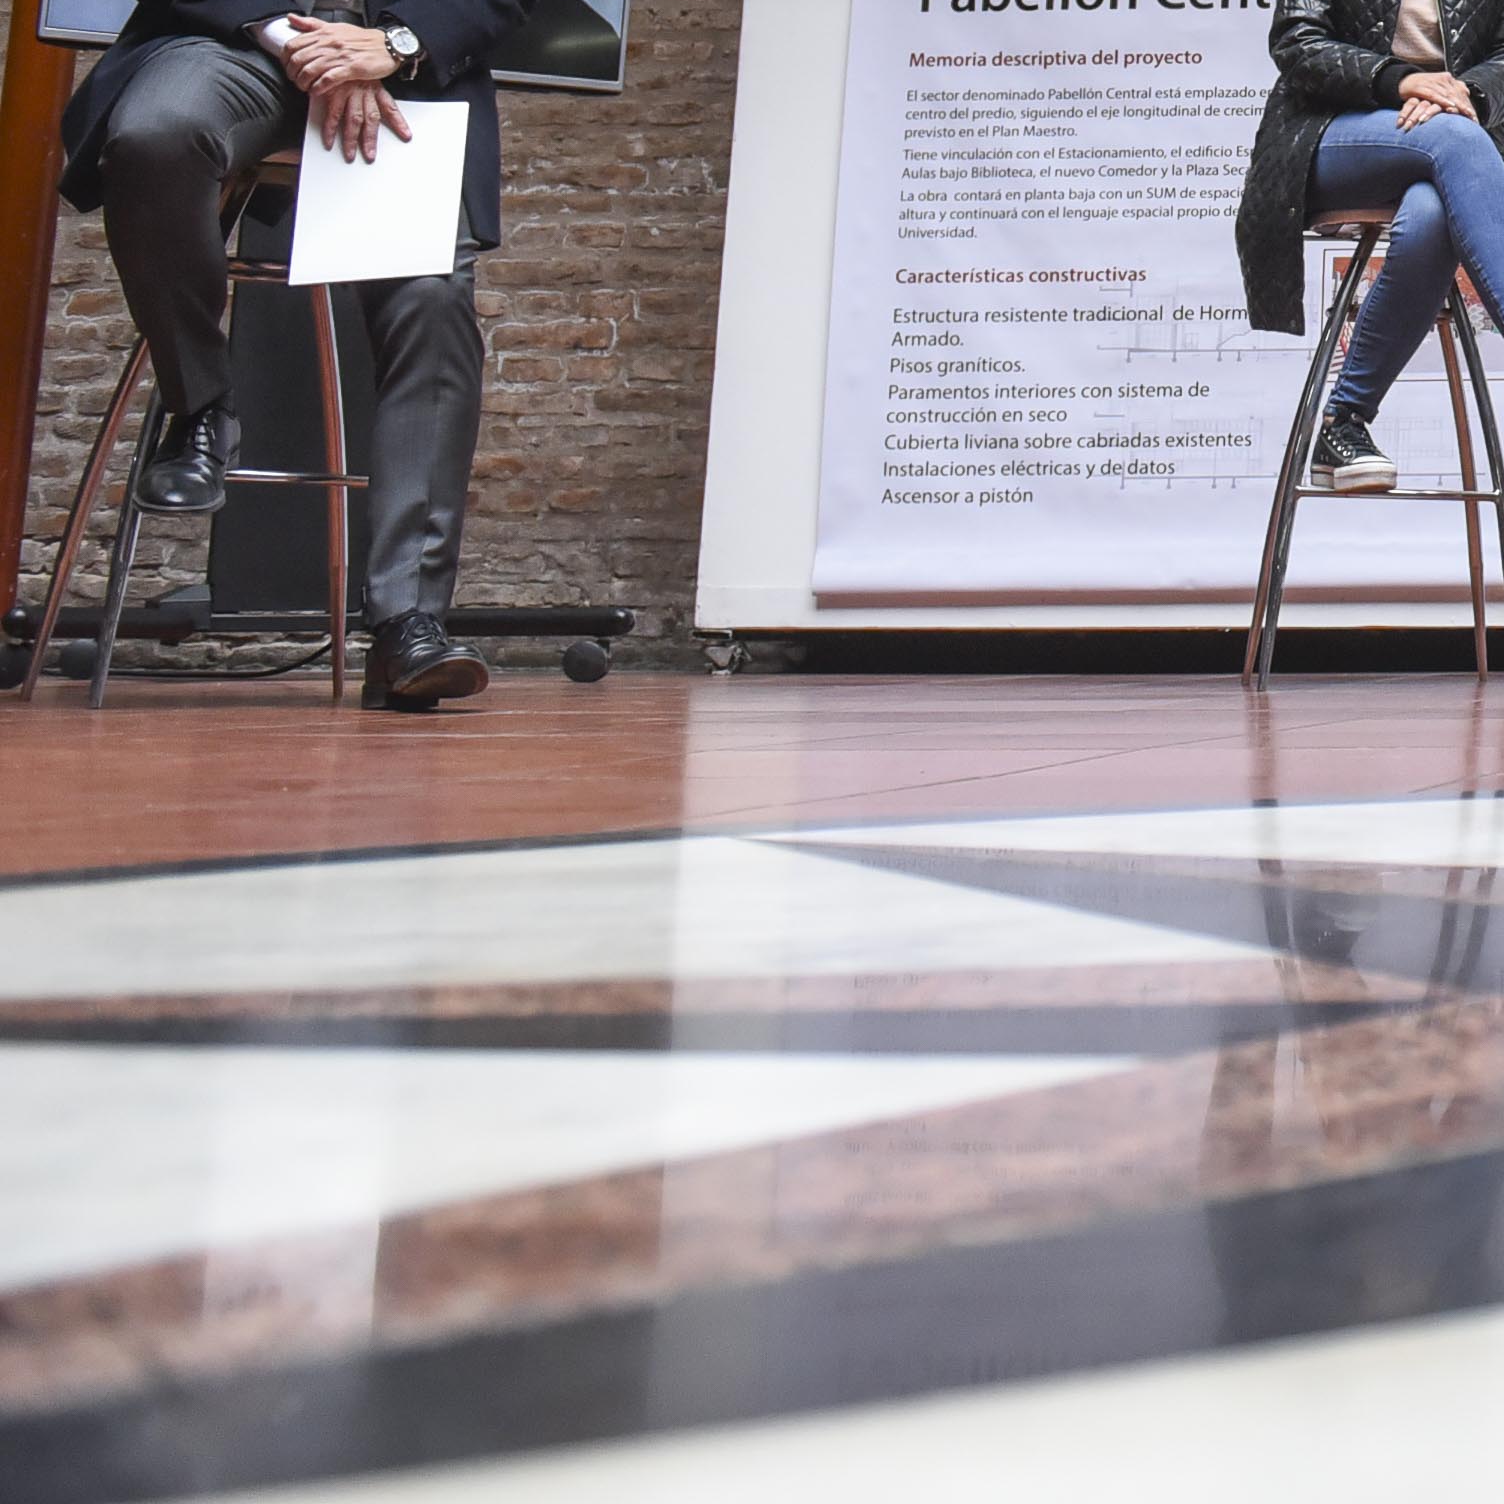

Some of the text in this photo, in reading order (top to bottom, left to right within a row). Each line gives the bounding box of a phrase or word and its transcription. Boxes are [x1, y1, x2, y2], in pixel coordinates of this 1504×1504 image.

[910, 50, 1202, 69] Memoria descriptiva del proyecto
[907, 90, 917, 101] El
[921, 91, 959, 101] sector
[962, 89, 1045, 101] denominado
[1048, 88, 1102, 99] Pabellón
[1106, 87, 1151, 99] Central
[1155, 89, 1181, 99] está
[1185, 86, 1256, 100] emplazado
[906, 105, 1266, 122] centro del predio, siguiendo eje longitudinal de crecim
[904, 125, 1077, 140] previsto Plan Maestro.
[904, 149, 937, 160] Tiene
[941, 148, 1012, 160] vinculación
[1016, 151, 1039, 159] con
[1059, 147, 1166, 159] Estacionamiento,
[1185, 145, 1232, 157] edificio
[902, 168, 936, 179] Aulas
[940, 167, 968, 181] bajo
[971, 166, 1035, 178] Biblioteca,
[1055, 168, 1095, 177] nuevo
[1098, 164, 1157, 177] Comedor
[1187, 164, 1218, 176] Plaza
[900, 190, 914, 201] La
[918, 190, 947, 201] obra
[954, 189, 1001, 201] contará
[1025, 189, 1064, 203] planta
[1069, 188, 1095, 202] baja
[1099, 191, 1122, 199] con
[1127, 190, 1142, 199] un
[1147, 187, 1176, 199] SUM
[1180, 187, 1196, 198] de
[899, 208, 935, 220] altura
[950, 208, 1017, 219] continuará
[1021, 210, 1044, 219] con
[1063, 207, 1118, 221] lenguaje
[1122, 206, 1173, 220] espacial
[1177, 208, 1220, 220] propio
[898, 226, 976, 238] Universidad.
[896, 267, 1146, 283] Características constructivas
[894, 309, 978, 323] Estructura
[985, 308, 1068, 322] resistente
[1073, 305, 1163, 321] tradicional
[1173, 305, 1194, 320] de
[892, 331, 963, 346] Armado.
[890, 357, 1025, 377] Pisos graníticos.
[889, 381, 1209, 399] Paramentos interiores con sistema de
[887, 407, 1067, 423] construcción seco
[885, 432, 1251, 450] Cubierta liviana sobre cabriadas existentes
[884, 459, 1174, 477] Instalaciones eléctricas de datos
[882, 488, 1033, 506] Ascensor pistón
